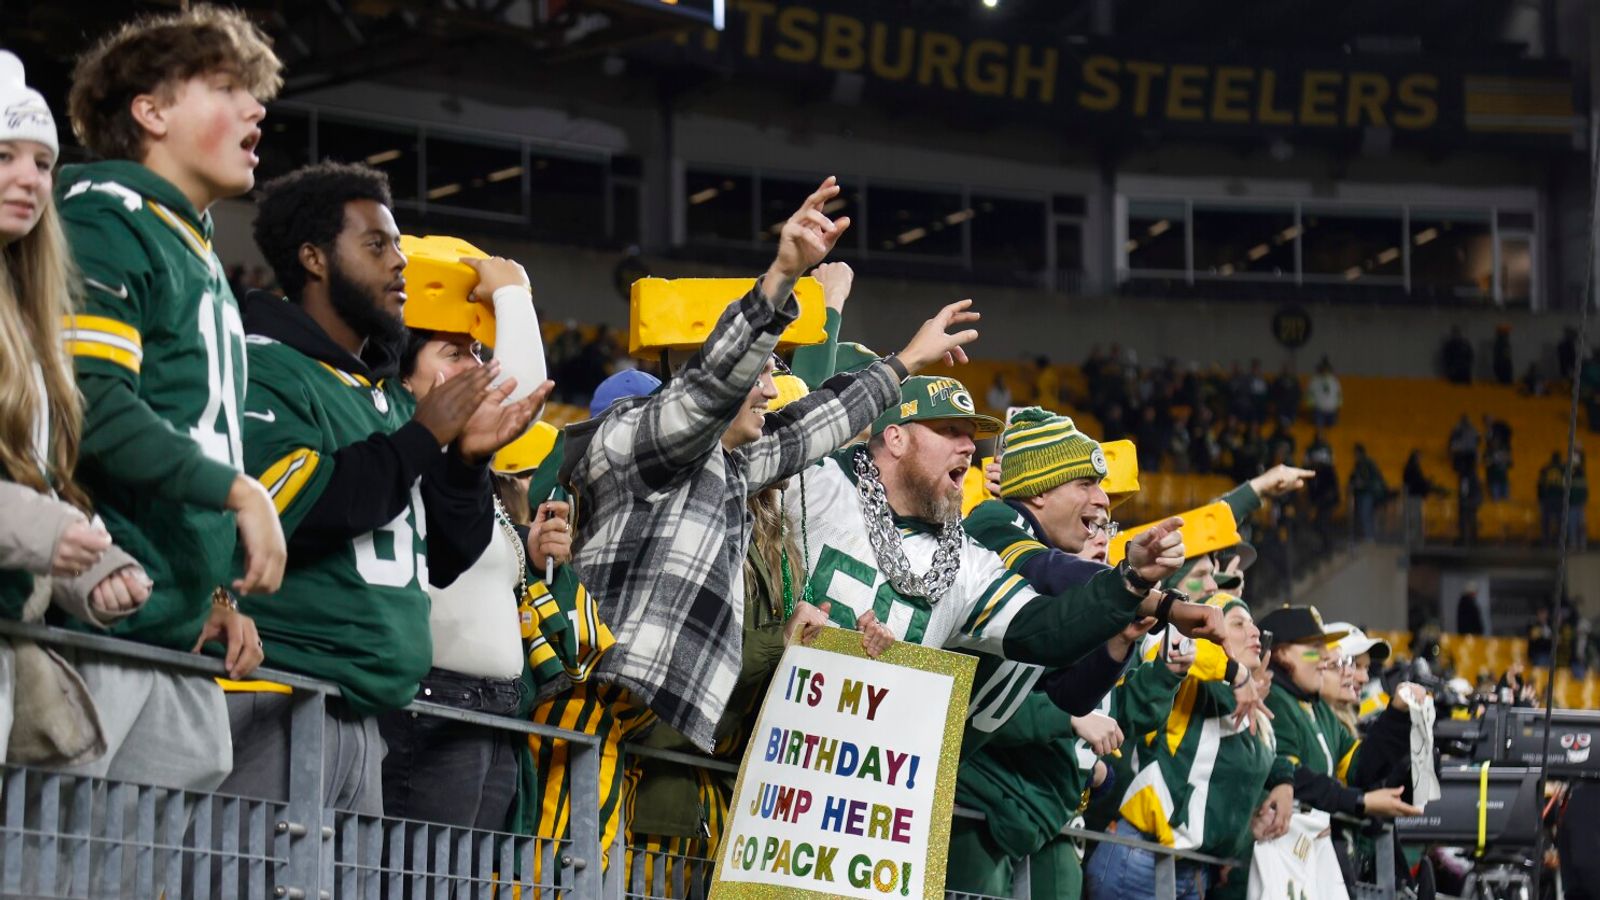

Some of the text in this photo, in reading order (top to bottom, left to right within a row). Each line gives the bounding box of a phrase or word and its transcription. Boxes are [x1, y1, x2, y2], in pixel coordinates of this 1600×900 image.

[1077, 53, 1440, 129] STEELERS
[785, 665, 889, 721] ITS MY
[764, 727, 921, 790] BIRTHDAY!
[750, 782, 914, 844] JUMP HERE
[731, 834, 912, 897] GO PACK GO!
